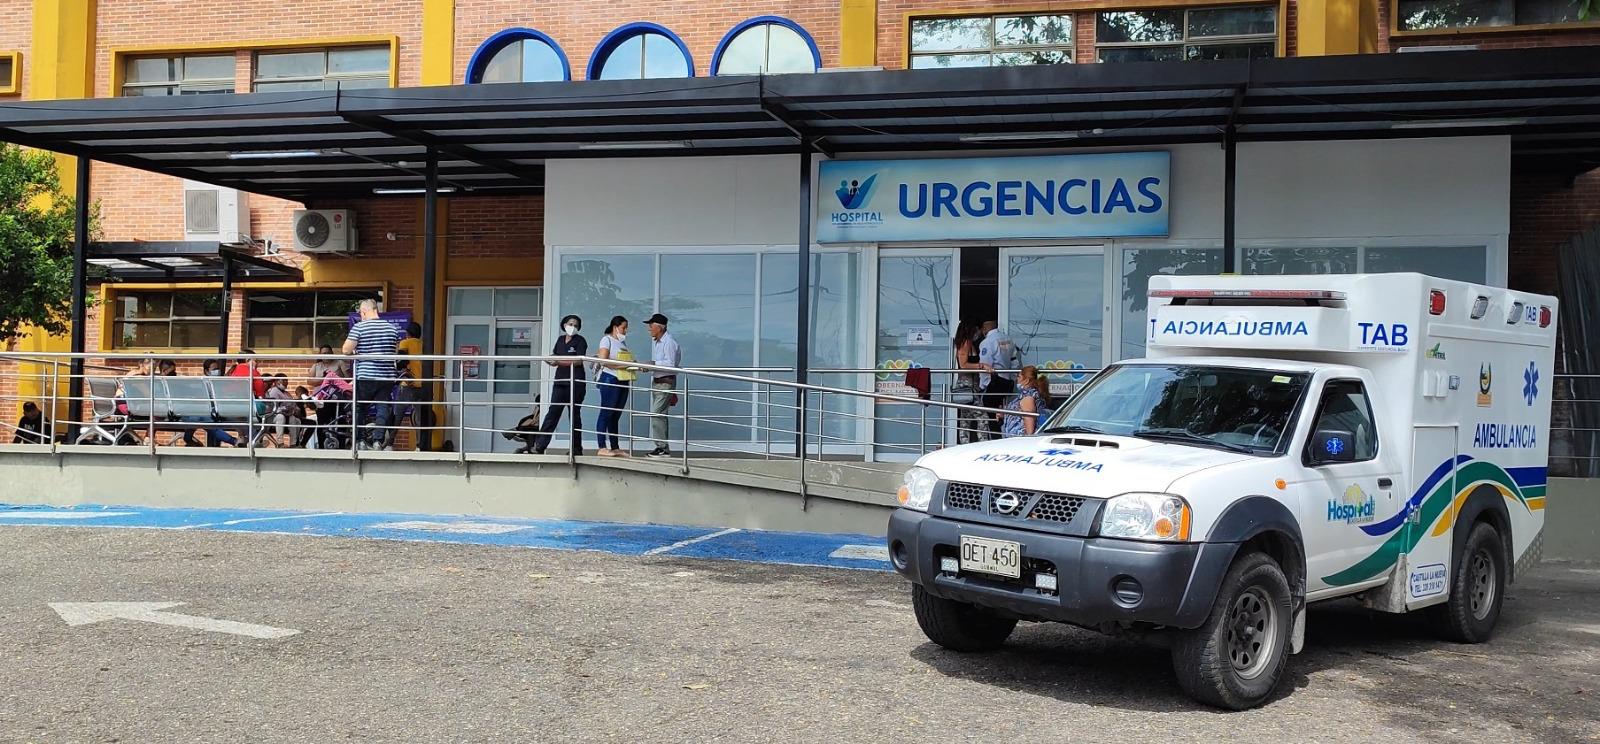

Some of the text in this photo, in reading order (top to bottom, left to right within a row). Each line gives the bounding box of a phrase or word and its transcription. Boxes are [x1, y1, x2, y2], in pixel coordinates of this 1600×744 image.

[898, 177, 1163, 219] URGENCIAS
[831, 211, 884, 223] HOSPITAL
[1524, 304, 1537, 321] TAB
[1357, 322, 1409, 346] TAB
[1472, 423, 1537, 449] AMBULANCIA
[963, 542, 1017, 568] OET 450
